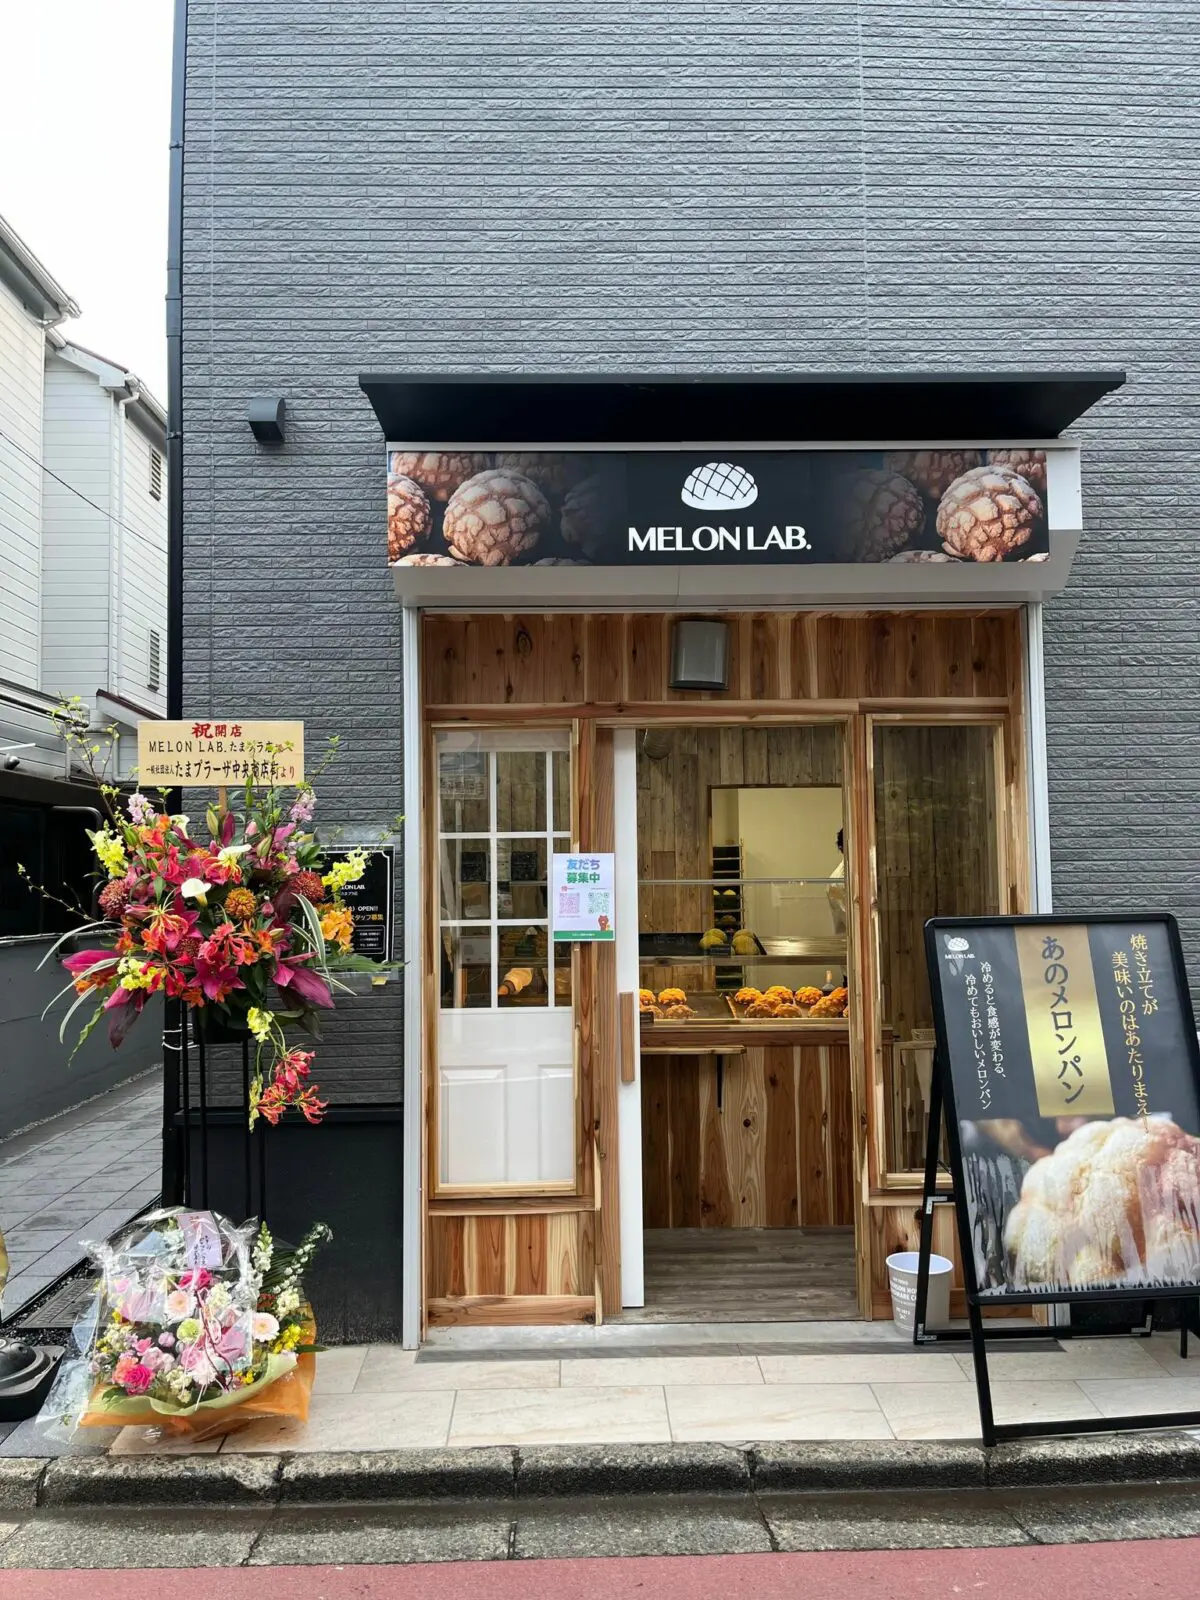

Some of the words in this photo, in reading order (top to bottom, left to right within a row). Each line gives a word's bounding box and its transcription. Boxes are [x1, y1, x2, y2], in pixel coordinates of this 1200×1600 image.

[628, 526, 741, 551] MELON
[746, 525, 812, 550] LAB.
[191, 722, 243, 739] 祝開店
[148, 741, 193, 753] MELON
[199, 741, 227, 753] LAB.
[566, 858, 601, 870] 友だち
[566, 871, 601, 883] 募集中
[1130, 933, 1159, 1015] 焼き立てが
[980, 961, 1006, 1078] 冷めると食感が変わる、
[1041, 935, 1085, 1105] あのメロンパン
[965, 974, 992, 1110] 冷めてもおいしいメロンパン
